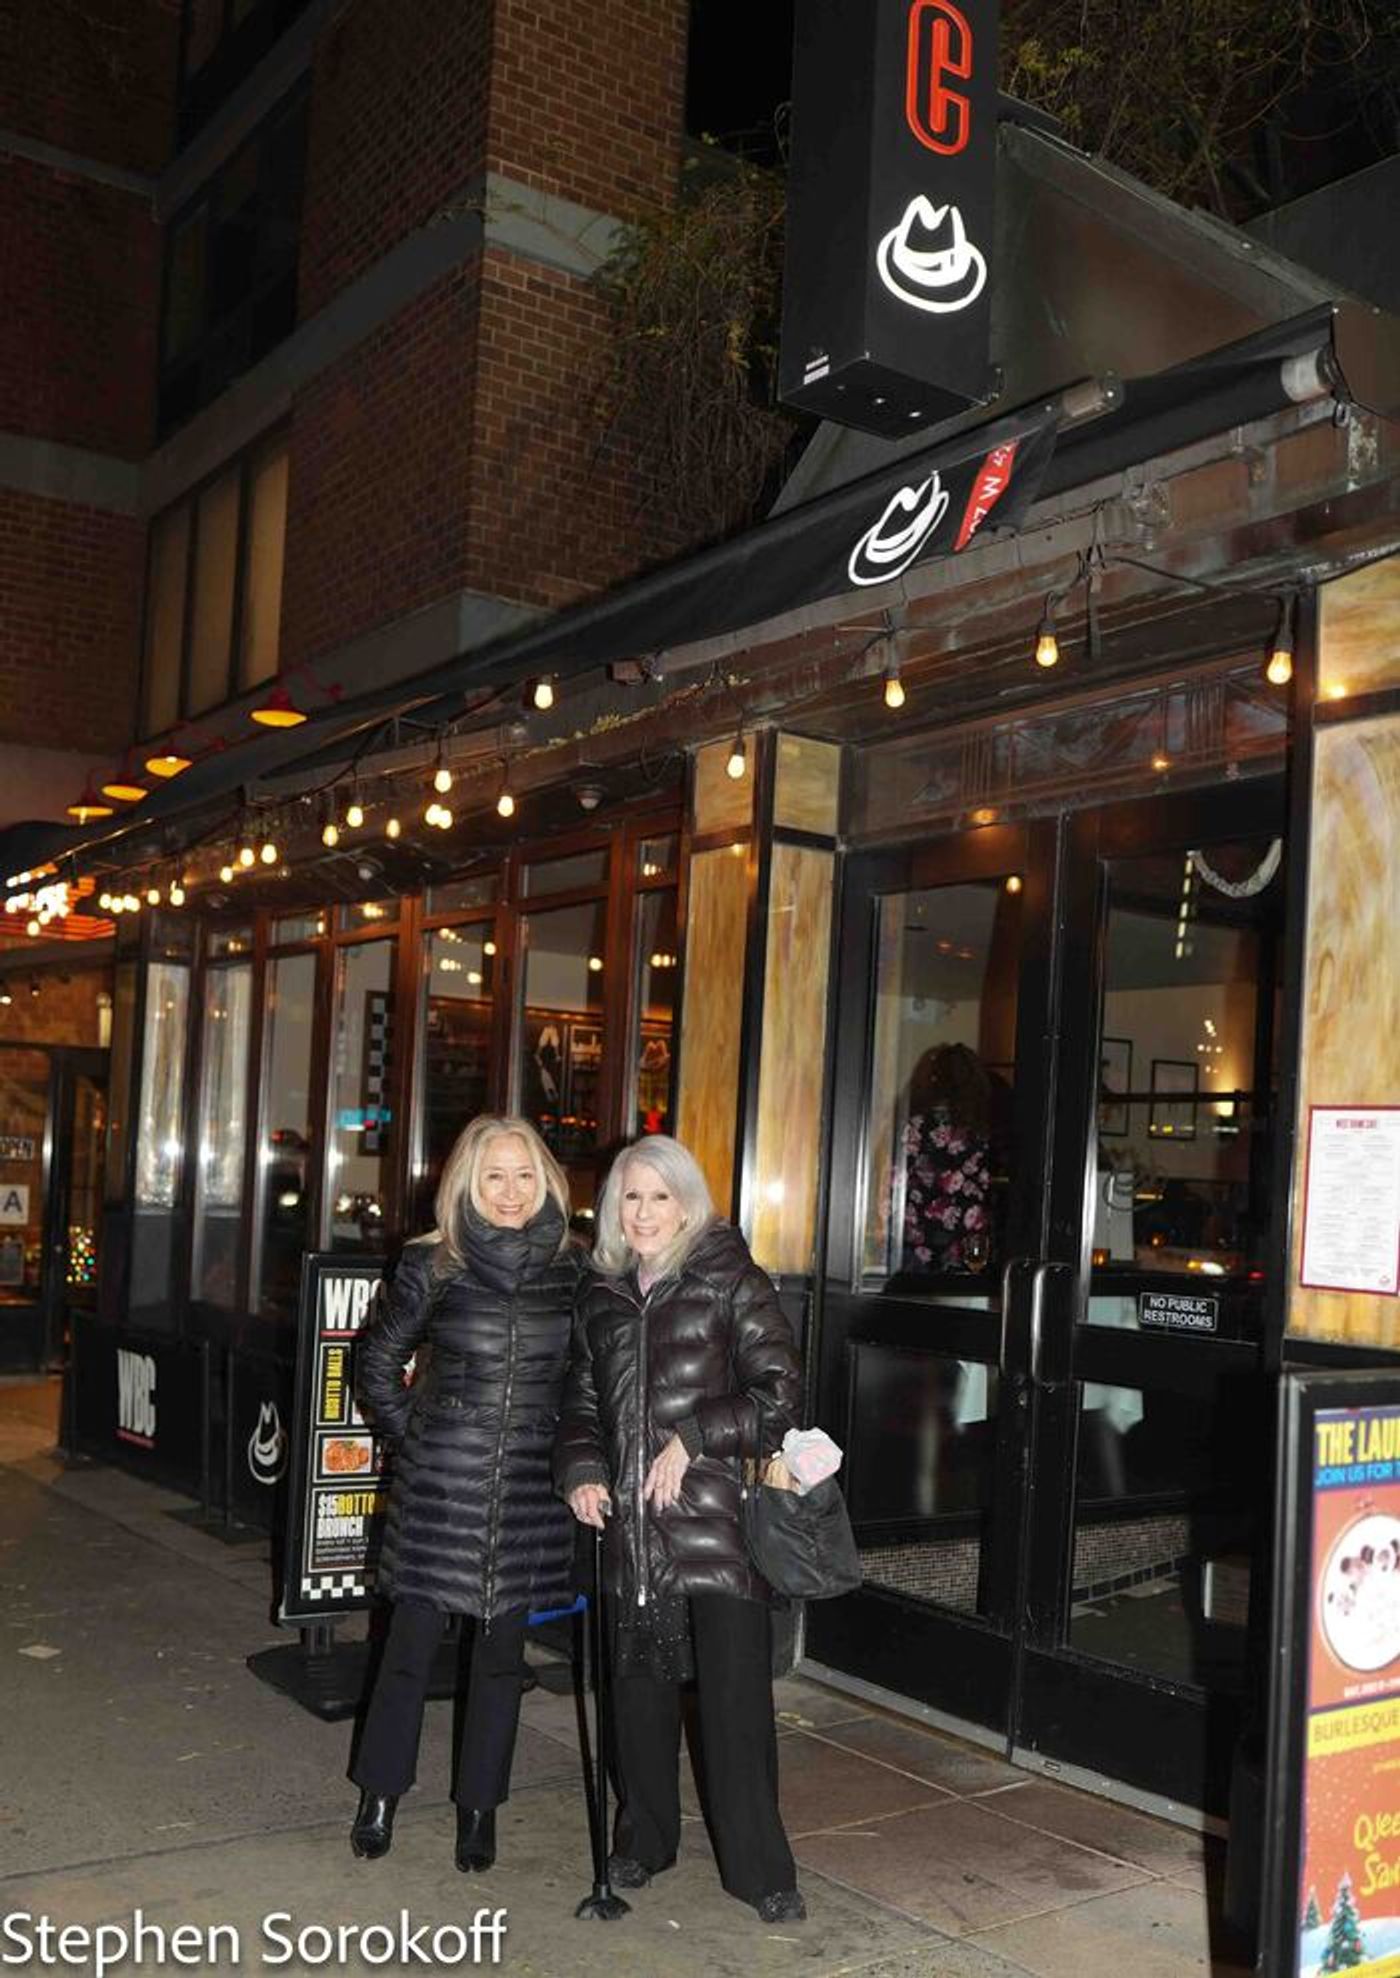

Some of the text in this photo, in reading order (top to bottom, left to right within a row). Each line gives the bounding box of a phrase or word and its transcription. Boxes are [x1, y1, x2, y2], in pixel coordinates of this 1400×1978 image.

[906, 0, 972, 155] C
[3, 1190, 23, 1213] A
[1144, 1309, 1213, 1328] RESTROOMS
[1150, 1297, 1207, 1313] NO PUBLIC
[117, 1348, 156, 1437] WBC
[1316, 1417, 1400, 1467] THE LAU
[1315, 1466, 1345, 1488] JOIN
[1348, 1464, 1365, 1482] US
[1367, 1461, 1393, 1480] FOR
[316, 1516, 363, 1539] BRUNCH
[1313, 1708, 1400, 1743] BURLESQUE
